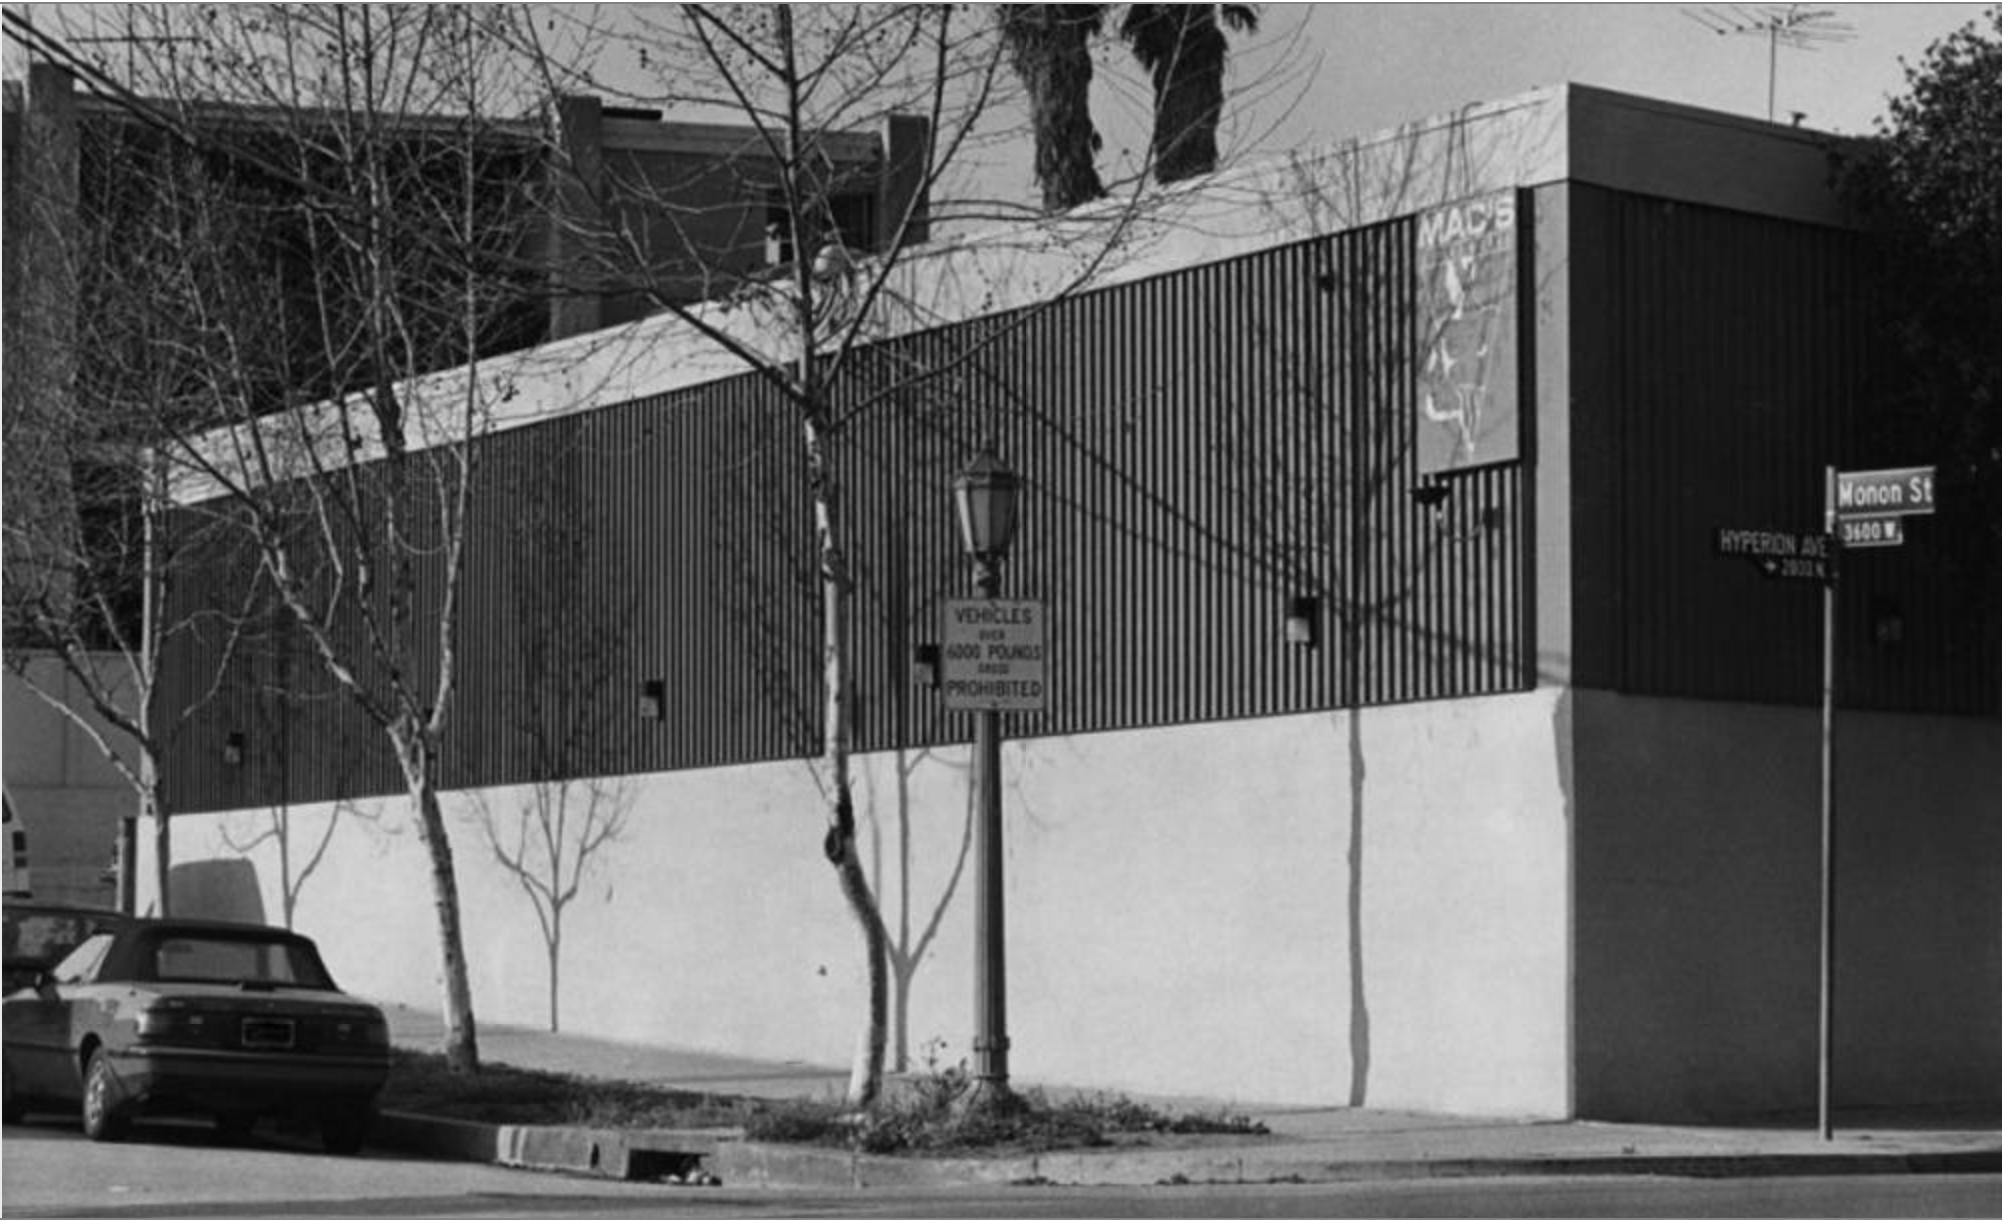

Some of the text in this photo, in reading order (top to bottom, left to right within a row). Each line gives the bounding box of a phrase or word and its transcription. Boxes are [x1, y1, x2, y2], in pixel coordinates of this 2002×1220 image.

[1417, 197, 1514, 247] MAC'S
[1838, 476, 1933, 507] Monon St
[1844, 521, 1896, 541] 3600 W
[1720, 528, 1828, 558] HYPERION AVE
[955, 608, 1031, 624] VEHICLES
[979, 630, 1005, 641] OVER
[946, 643, 1041, 660] 6000 POUNDS
[946, 679, 1042, 697] PROHIBITED
